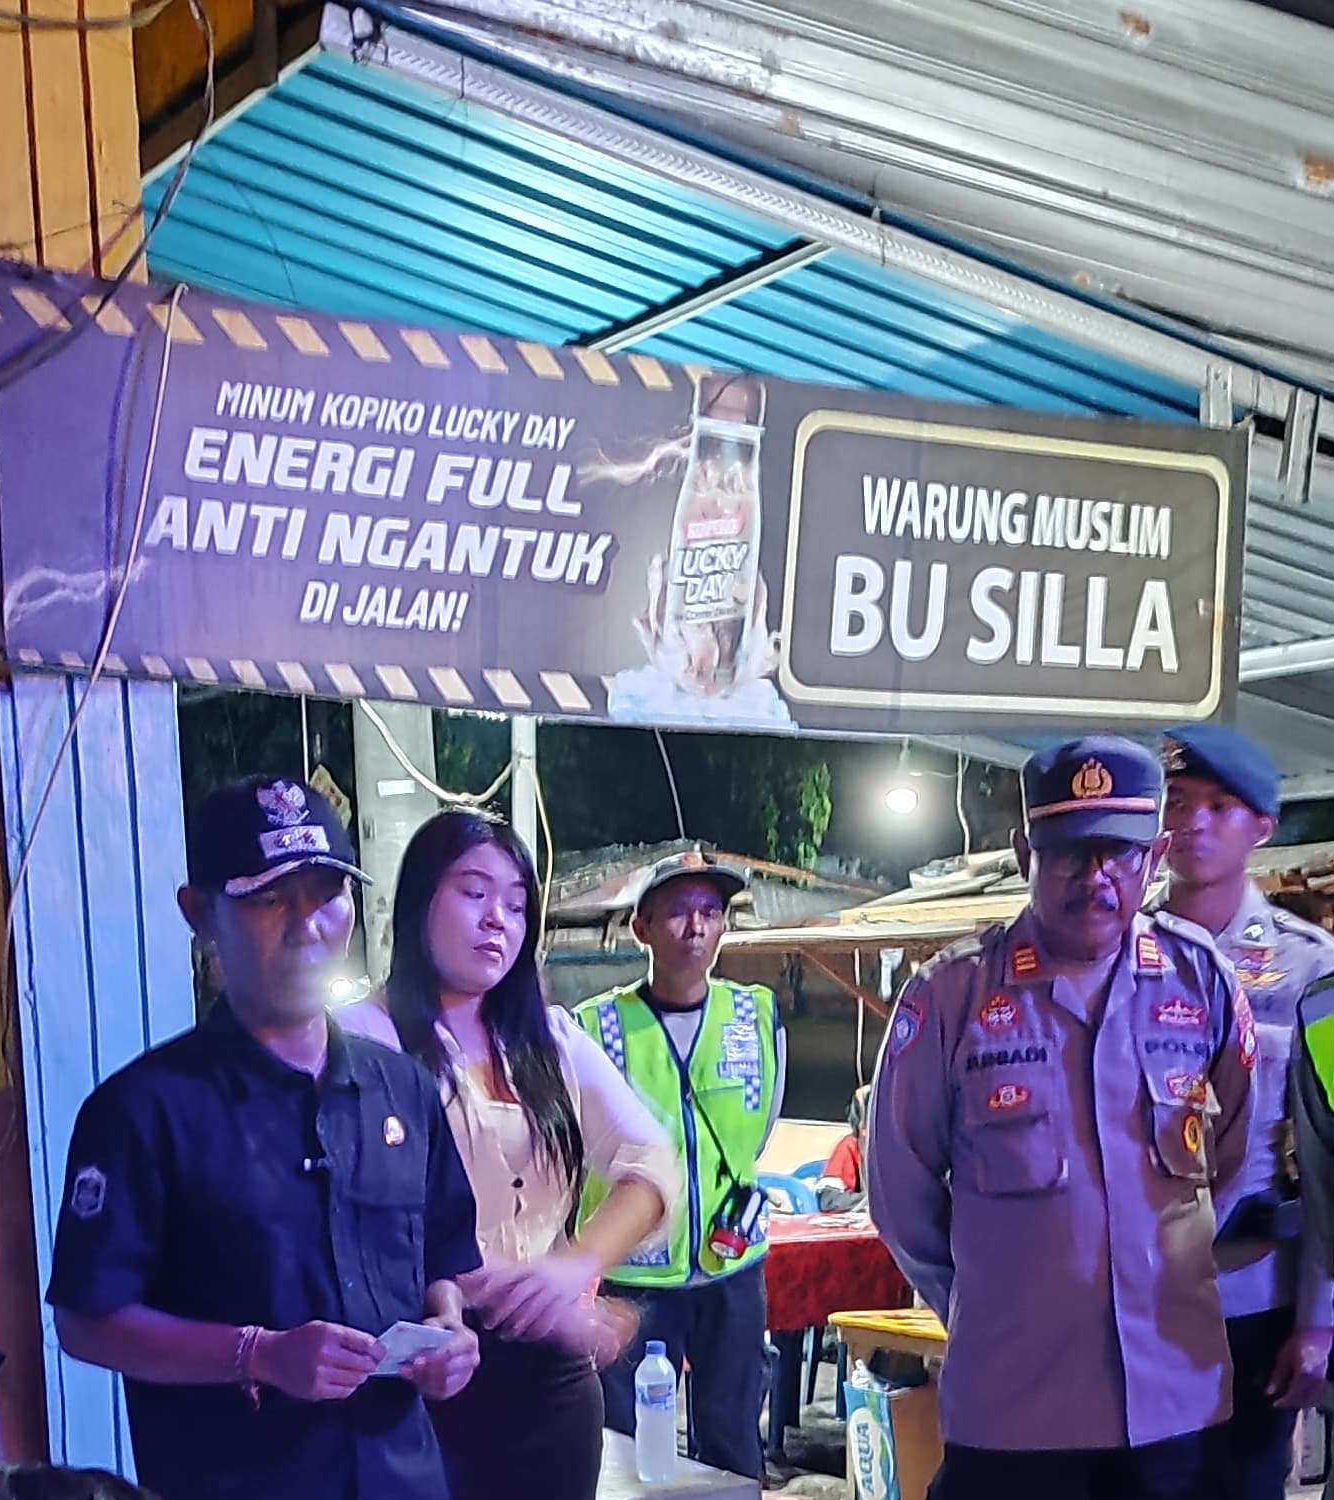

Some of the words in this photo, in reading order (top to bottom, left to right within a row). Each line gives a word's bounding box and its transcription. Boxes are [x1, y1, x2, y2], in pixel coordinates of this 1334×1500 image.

[216, 380, 315, 424] MINUM
[320, 391, 424, 435] KOPIKO
[428, 403, 520, 444] LUCKY
[522, 413, 576, 452] DAY
[184, 427, 415, 498] ENERGI
[427, 452, 582, 516] FULL
[145, 494, 307, 561] ANTI
[318, 513, 613, 585] NGANTUK
[863, 474, 1028, 546] WARUNG
[1031, 493, 1171, 560] MUSLIM
[300, 578, 338, 621] DI
[343, 583, 470, 633] JALAN!
[830, 555, 948, 661] BU
[967, 566, 1179, 674] SILLA
[857, 1422, 874, 1495] AQUA
